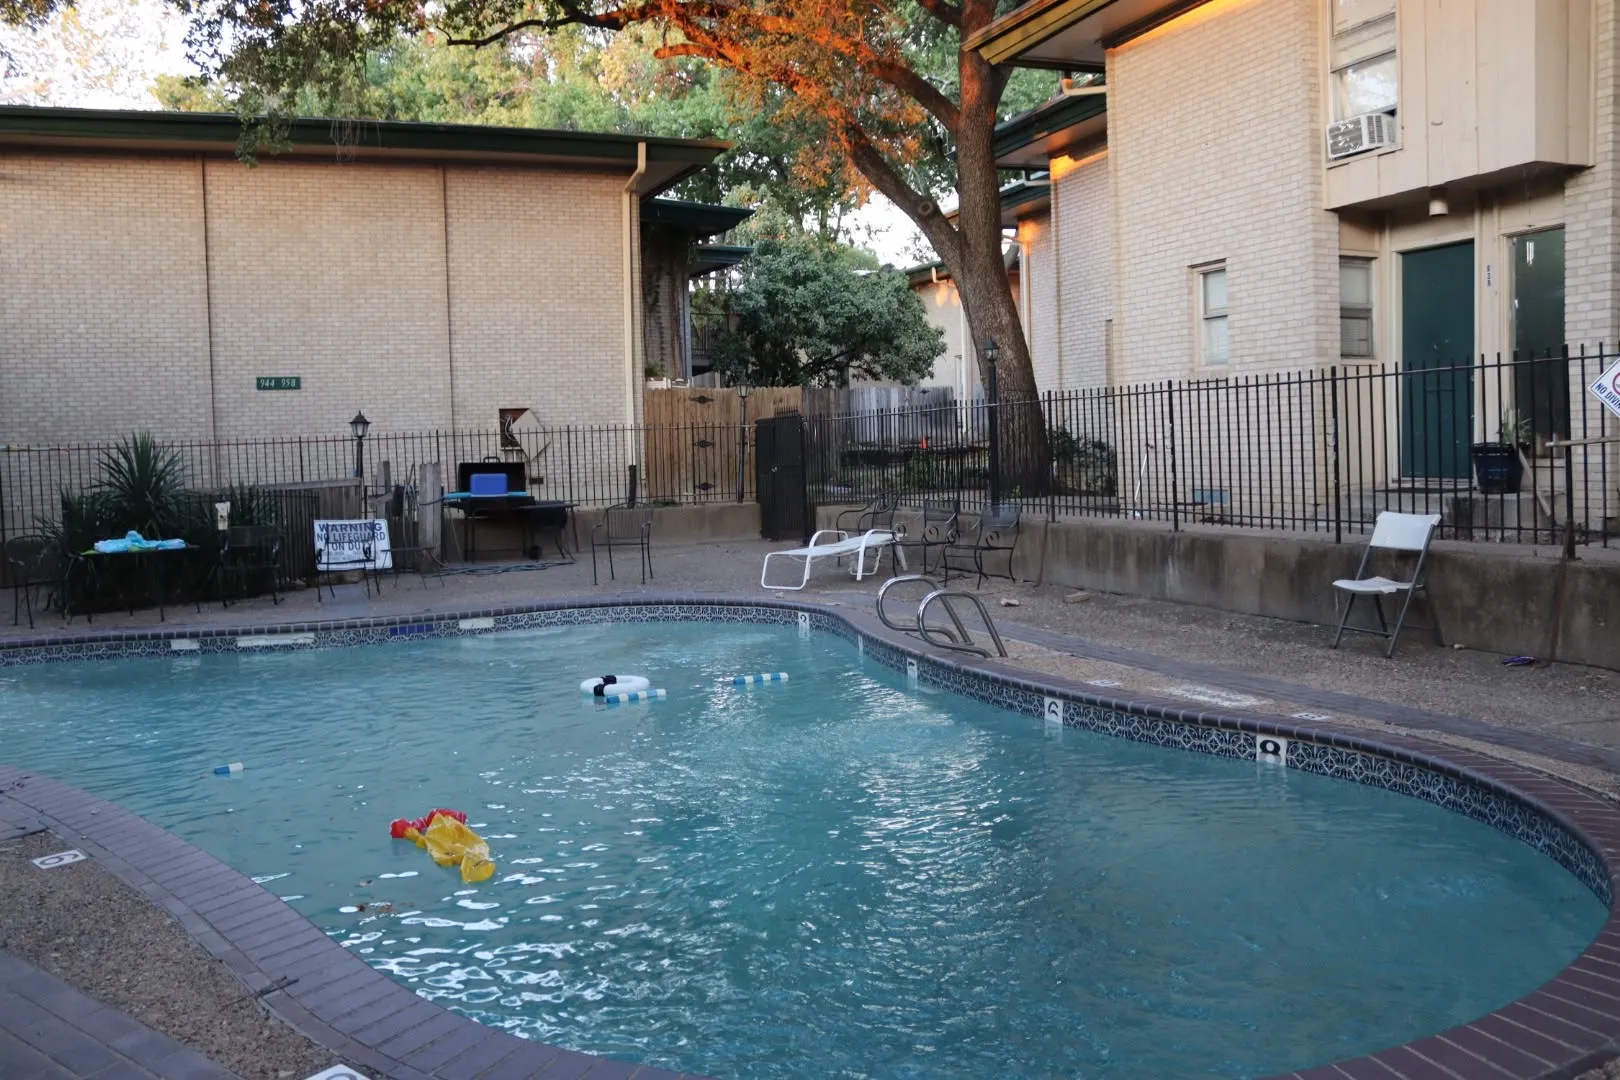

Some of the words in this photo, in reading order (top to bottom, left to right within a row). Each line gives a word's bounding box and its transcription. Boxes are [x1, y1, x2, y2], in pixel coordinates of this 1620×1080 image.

[260, 379, 275, 388] 944
[281, 378, 296, 388] 958
[1595, 382, 1607, 394] NO
[318, 523, 383, 533] WARNING
[333, 531, 385, 541] LIFEGUARD
[332, 541, 345, 551] ON
